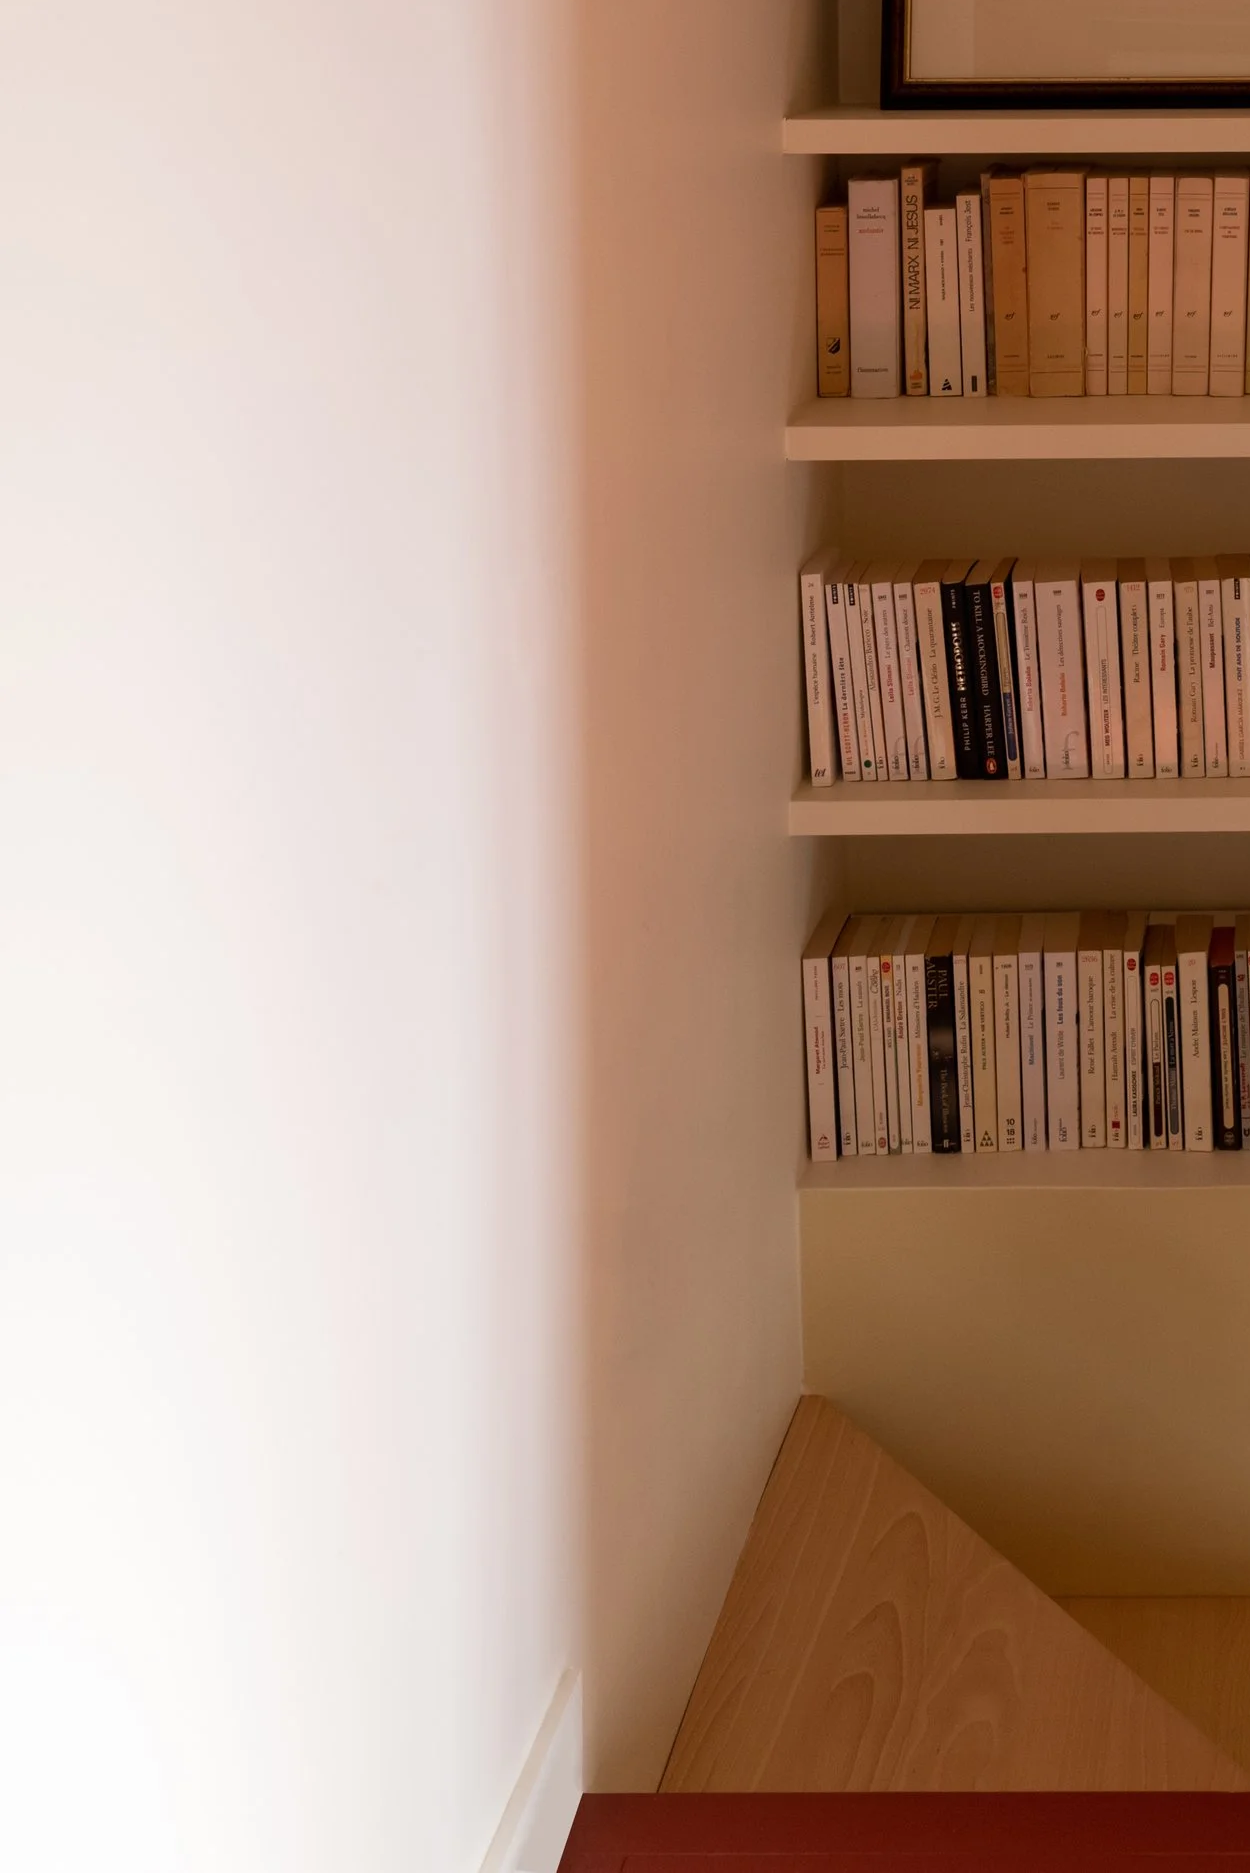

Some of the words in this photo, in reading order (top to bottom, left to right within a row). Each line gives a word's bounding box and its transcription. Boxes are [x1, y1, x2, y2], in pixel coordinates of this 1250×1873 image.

[905, 194, 918, 235] JESUS
[907, 239, 919, 250] NI
[908, 255, 920, 296] MARX
[909, 299, 920, 310] NI
[973, 589, 981, 603] TO
[974, 605, 983, 622] KILL
[976, 623, 984, 632] A
[960, 697, 969, 719] KERR
[962, 722, 972, 751] PHILIP
[986, 739, 995, 757] LEE
[938, 969, 948, 997] PAUL
[1006, 1118, 1015, 1126] 10
